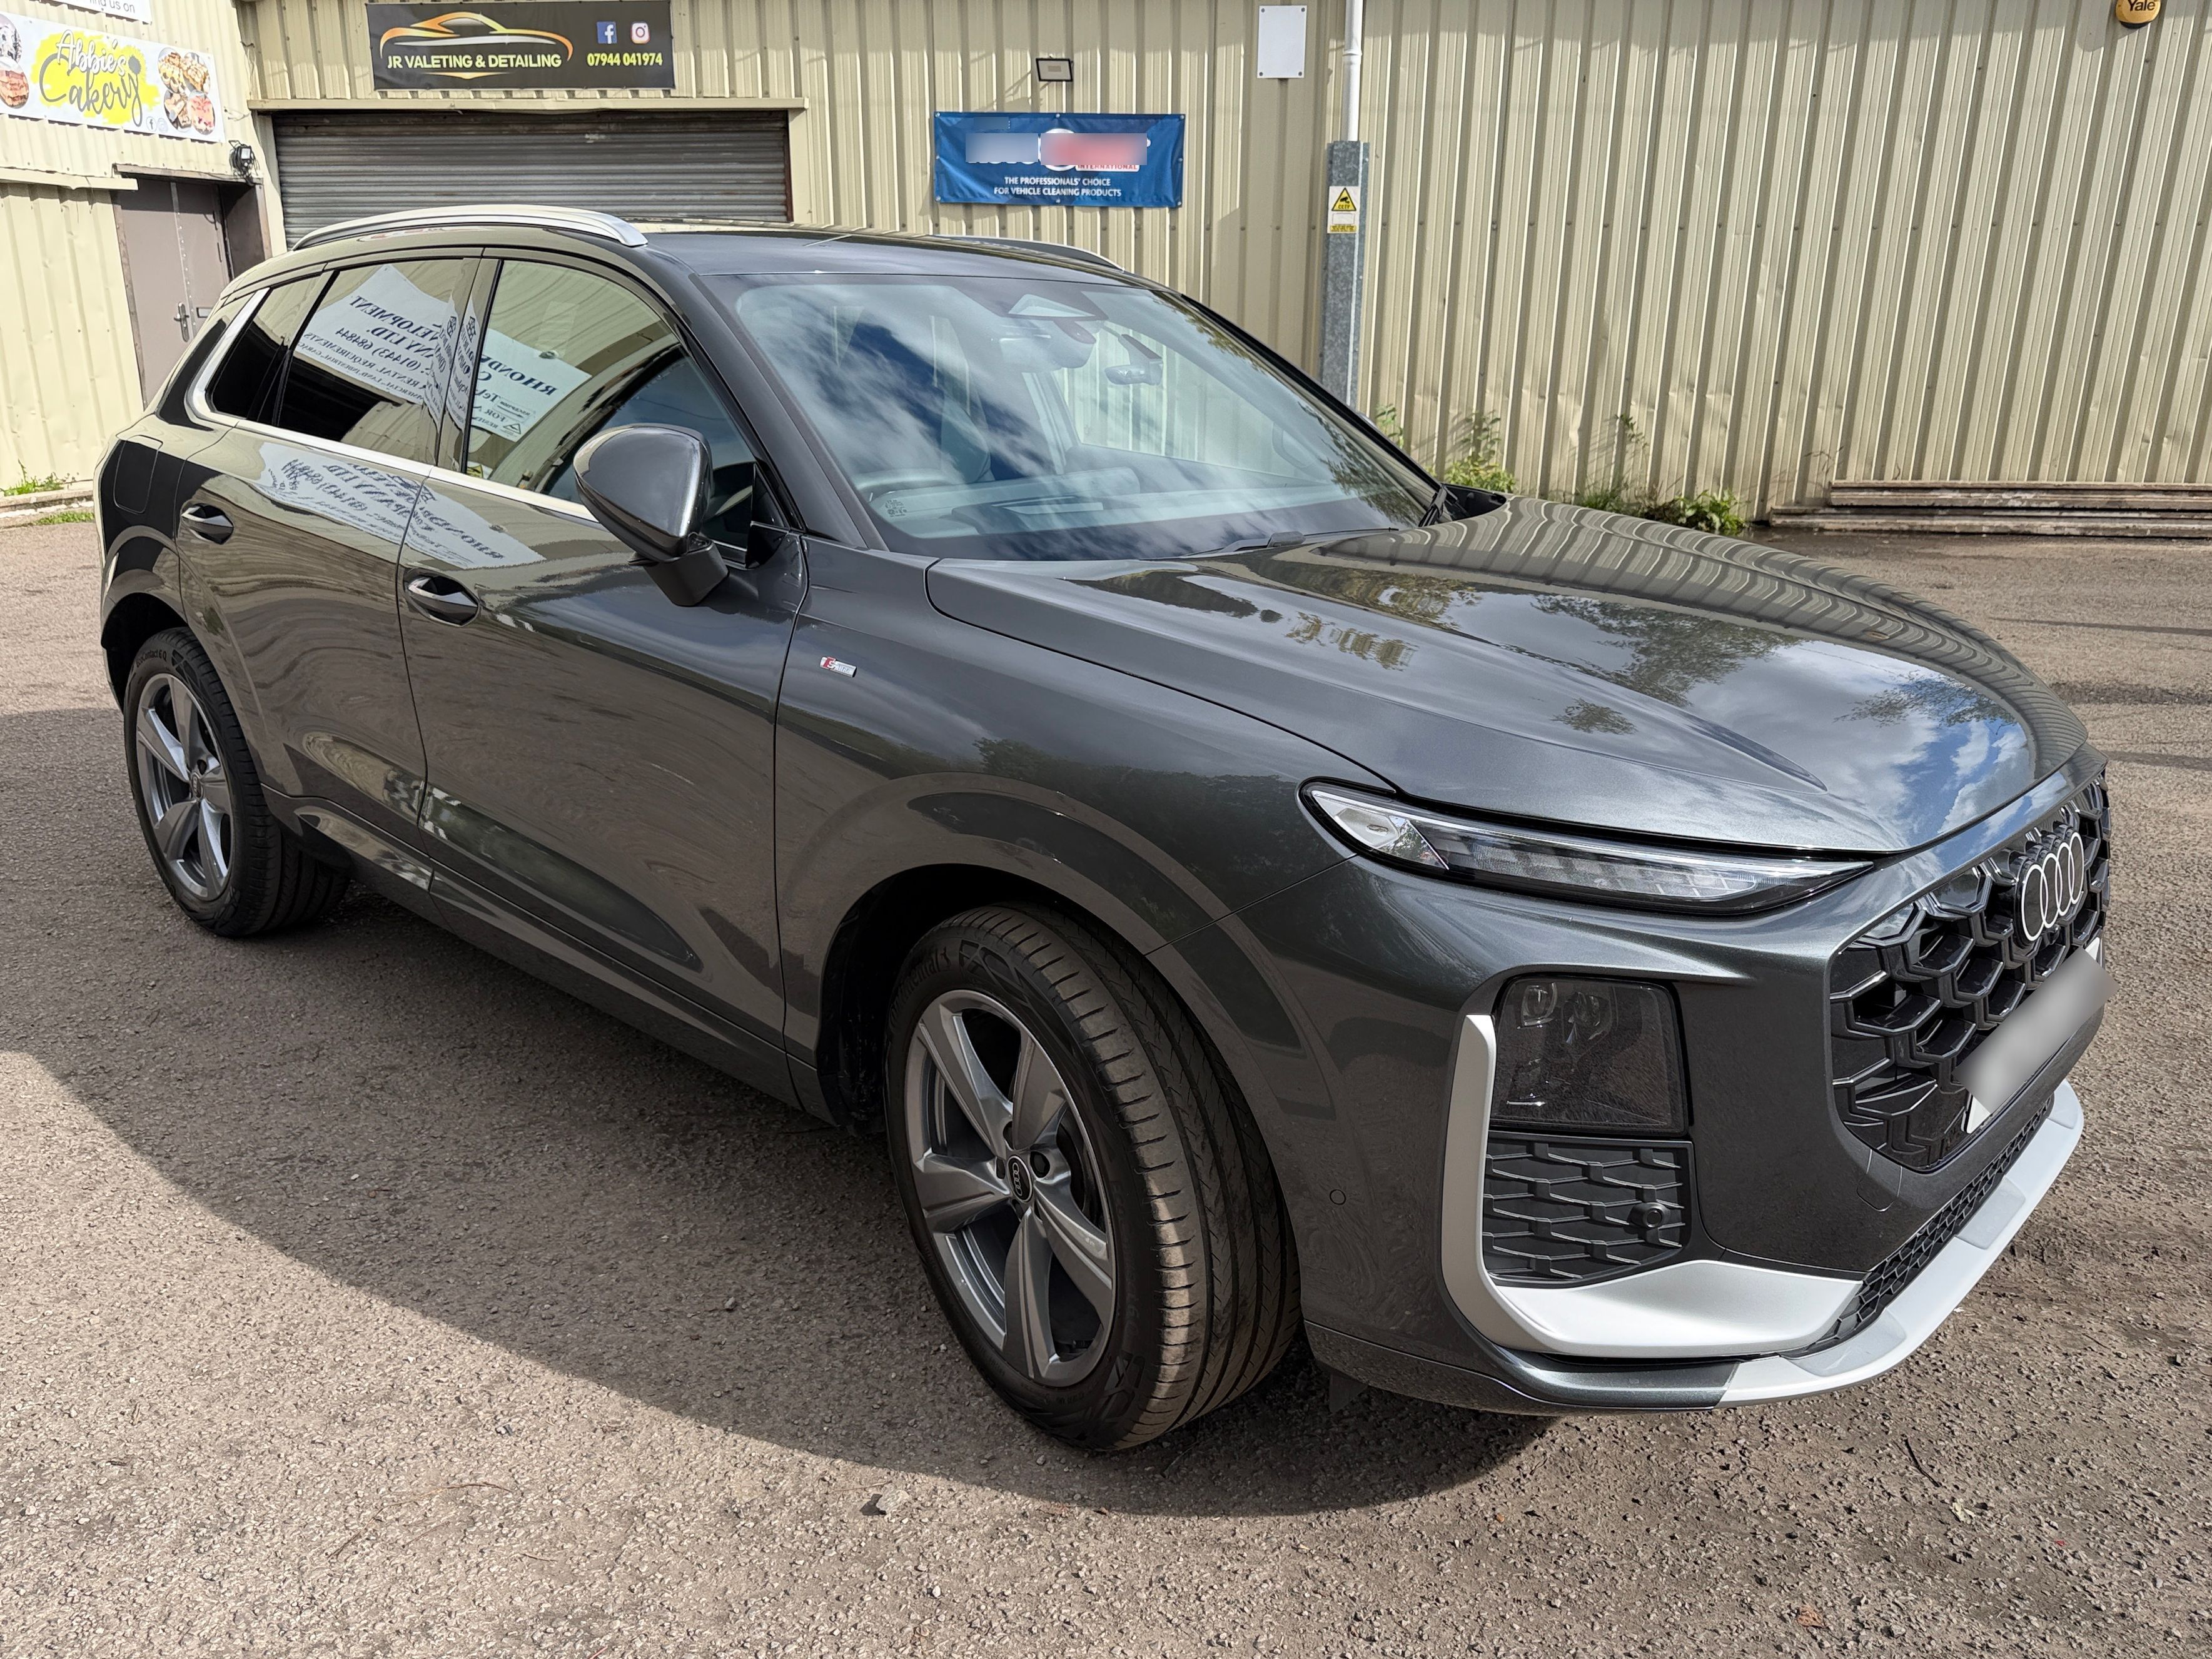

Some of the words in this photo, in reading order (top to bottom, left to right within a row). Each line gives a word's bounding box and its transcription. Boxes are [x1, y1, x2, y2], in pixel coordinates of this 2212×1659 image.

[109, 0, 121, 10] us
[123, 3, 135, 13] on
[2128, 0, 2156, 11] Yale
[56, 29, 127, 76] Abbie's
[387, 55, 403, 69] JR
[404, 54, 472, 68] VALETING
[475, 55, 486, 68] &
[488, 54, 562, 68] DETAILING
[586, 53, 621, 67] 07944
[623, 53, 663, 66] 041974
[39, 54, 142, 127] Cakery
[1004, 176, 1019, 185] THE
[1020, 177, 1081, 186] PROFESSIONALS'
[1082, 178, 1111, 186] CHOICE
[994, 187, 1010, 195] FOR
[1011, 187, 1041, 196] VEHICLE
[1042, 188, 1080, 196] CLEANING
[1081, 188, 1122, 197] PRODUCTS
